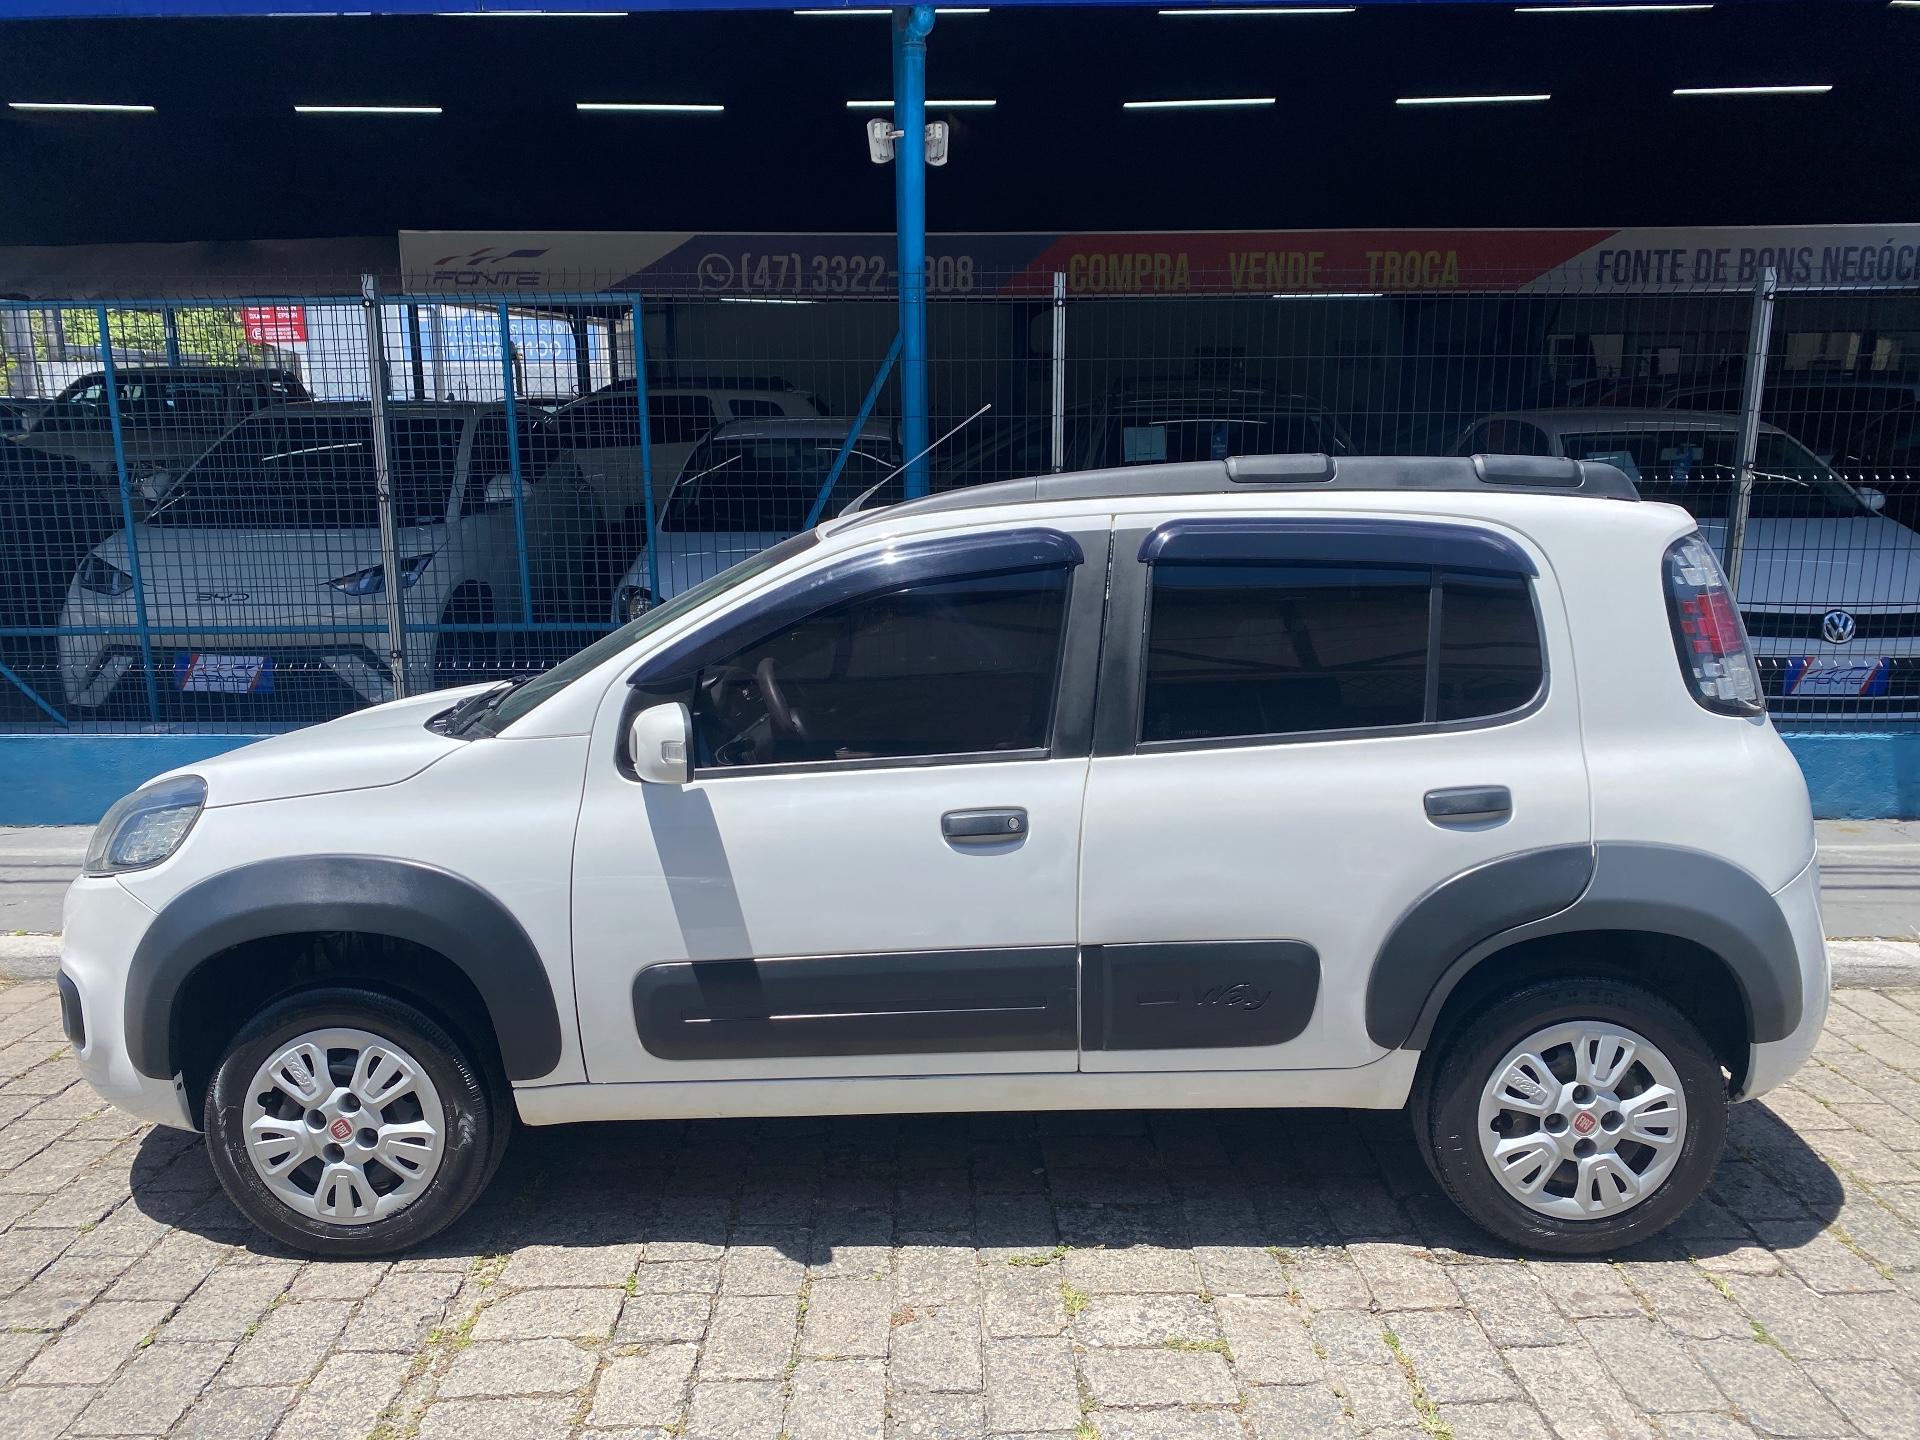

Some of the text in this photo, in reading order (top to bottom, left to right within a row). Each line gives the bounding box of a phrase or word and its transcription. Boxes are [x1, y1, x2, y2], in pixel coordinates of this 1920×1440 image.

[432, 271, 542, 286] FONTE
[741, 253, 802, 293] (47)
[1068, 250, 1459, 292] COMPRA VENDE TROCA
[1597, 248, 1687, 285] FONTE
[1693, 247, 1732, 284] DE
[1737, 246, 1813, 283] BONS
